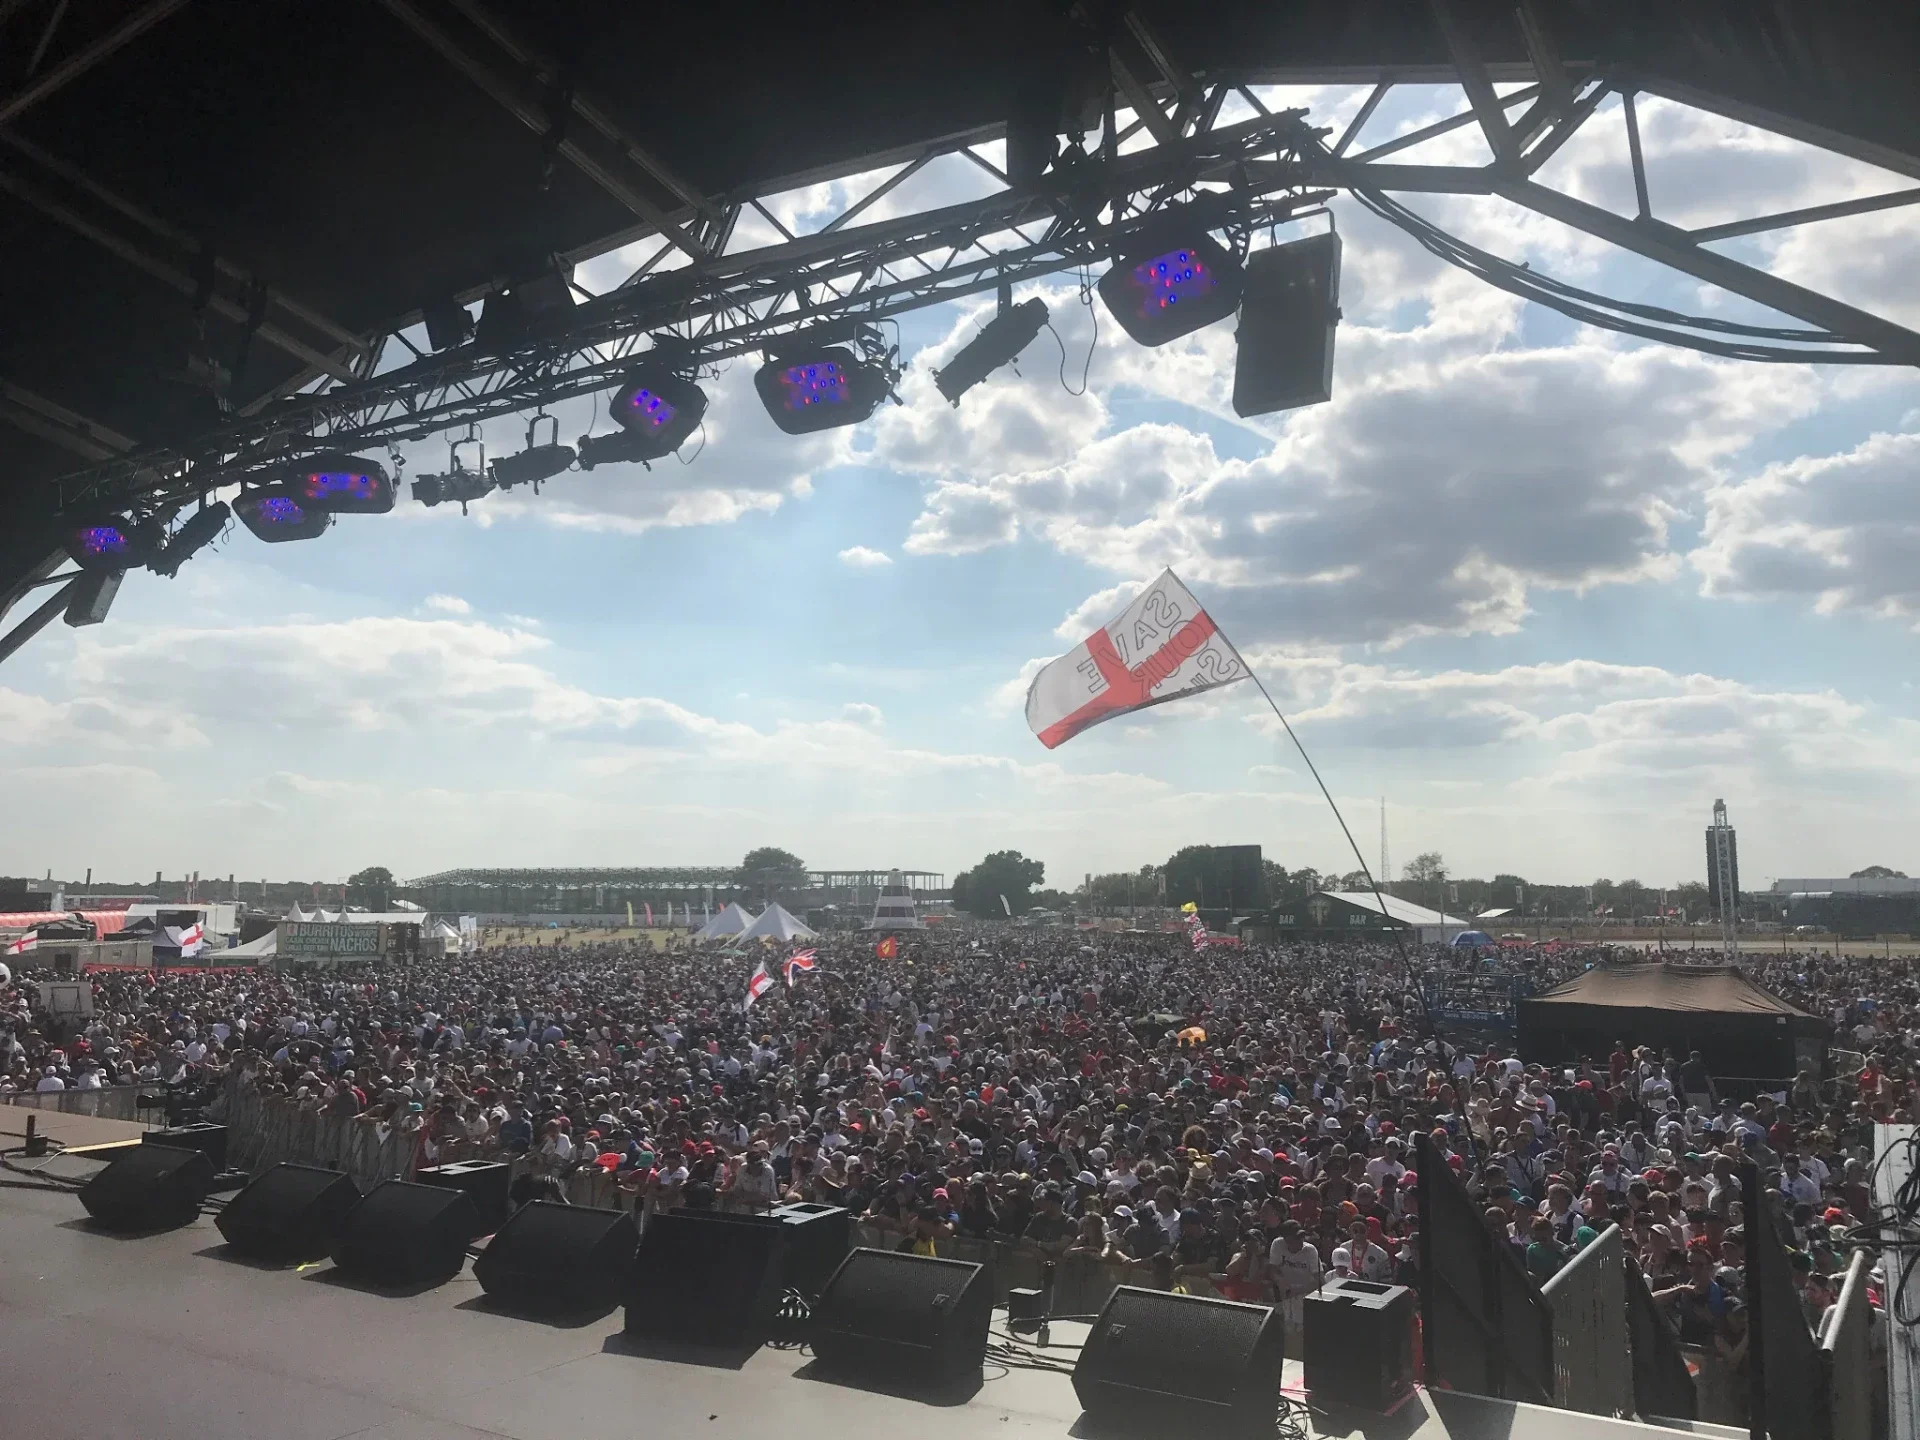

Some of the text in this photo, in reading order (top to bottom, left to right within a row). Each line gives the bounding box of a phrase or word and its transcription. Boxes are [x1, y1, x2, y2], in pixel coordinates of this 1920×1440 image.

[1278, 914, 1295, 925] BAR
[1349, 914, 1367, 925] BAR
[299, 924, 354, 937] BURRITOS
[330, 937, 377, 952] NACHOS
